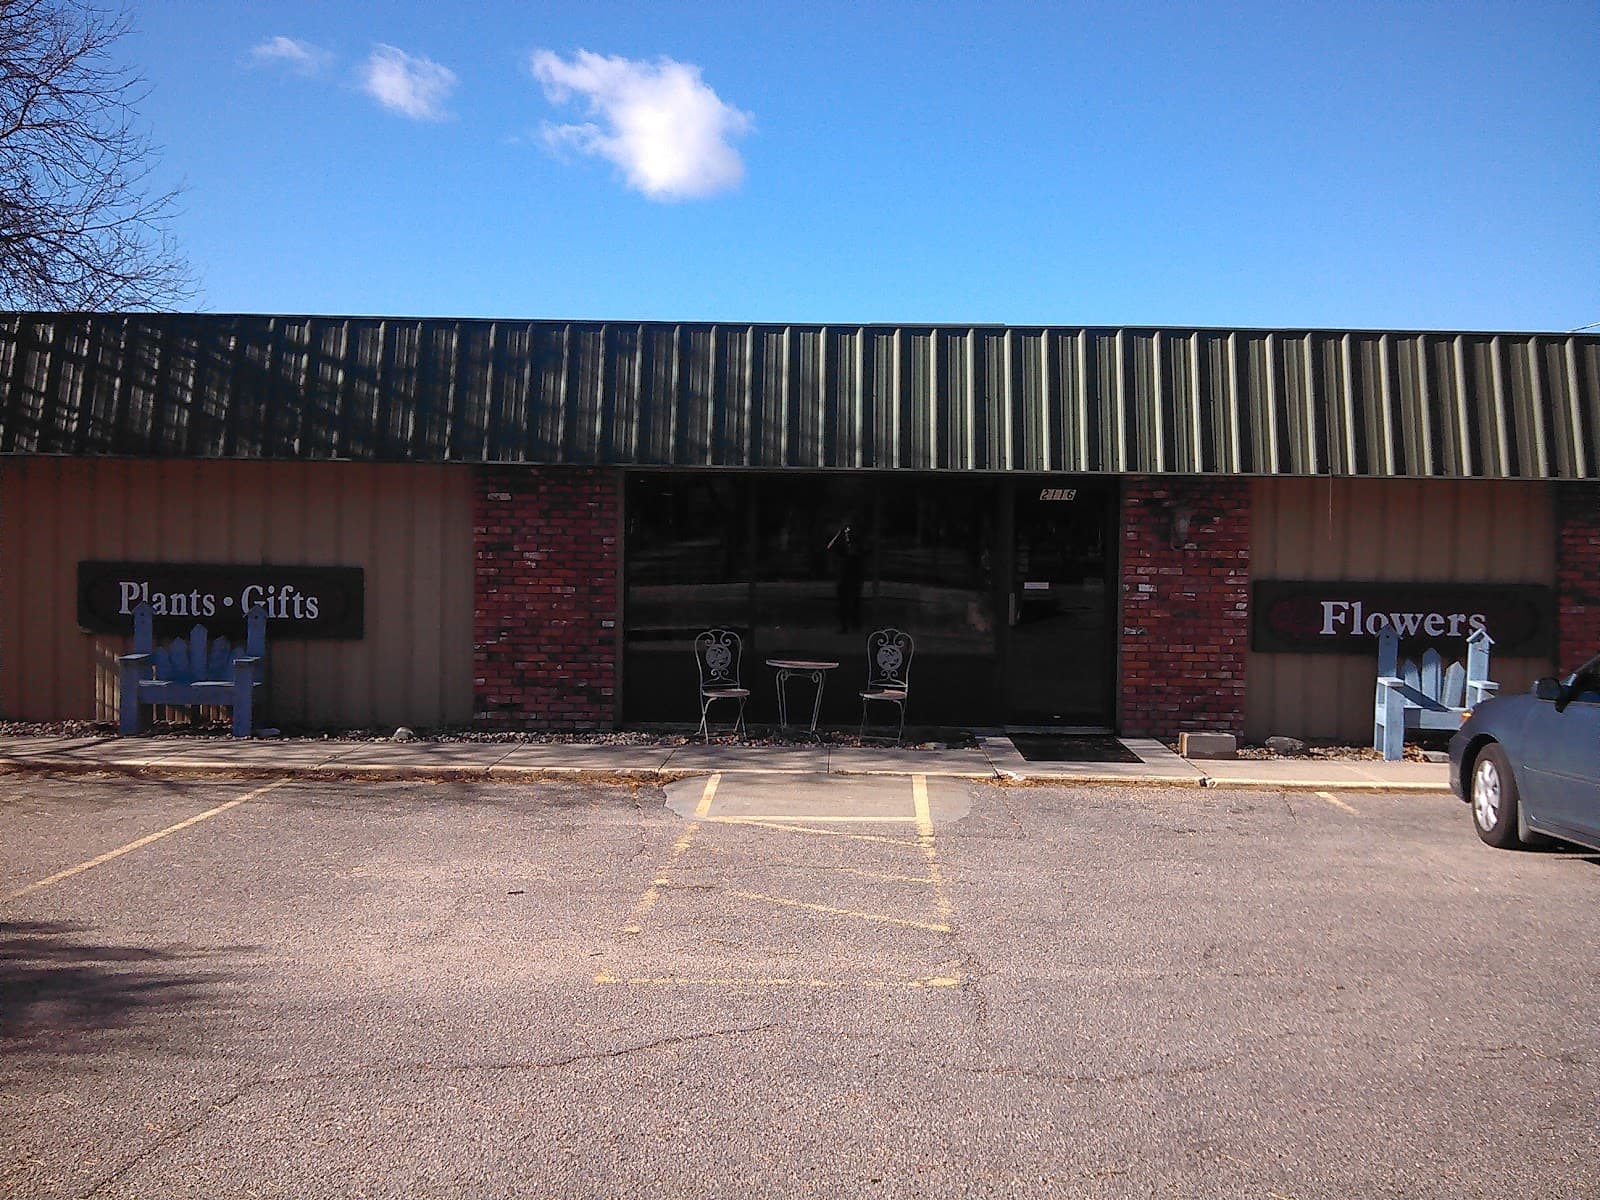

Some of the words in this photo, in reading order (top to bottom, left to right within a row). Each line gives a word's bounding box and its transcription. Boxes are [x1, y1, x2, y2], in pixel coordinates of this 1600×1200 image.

[1041, 489, 1075, 500] 2116
[118, 581, 216, 617] Plants
[241, 584, 320, 620] Gifts
[1319, 600, 1488, 638] Flowers
